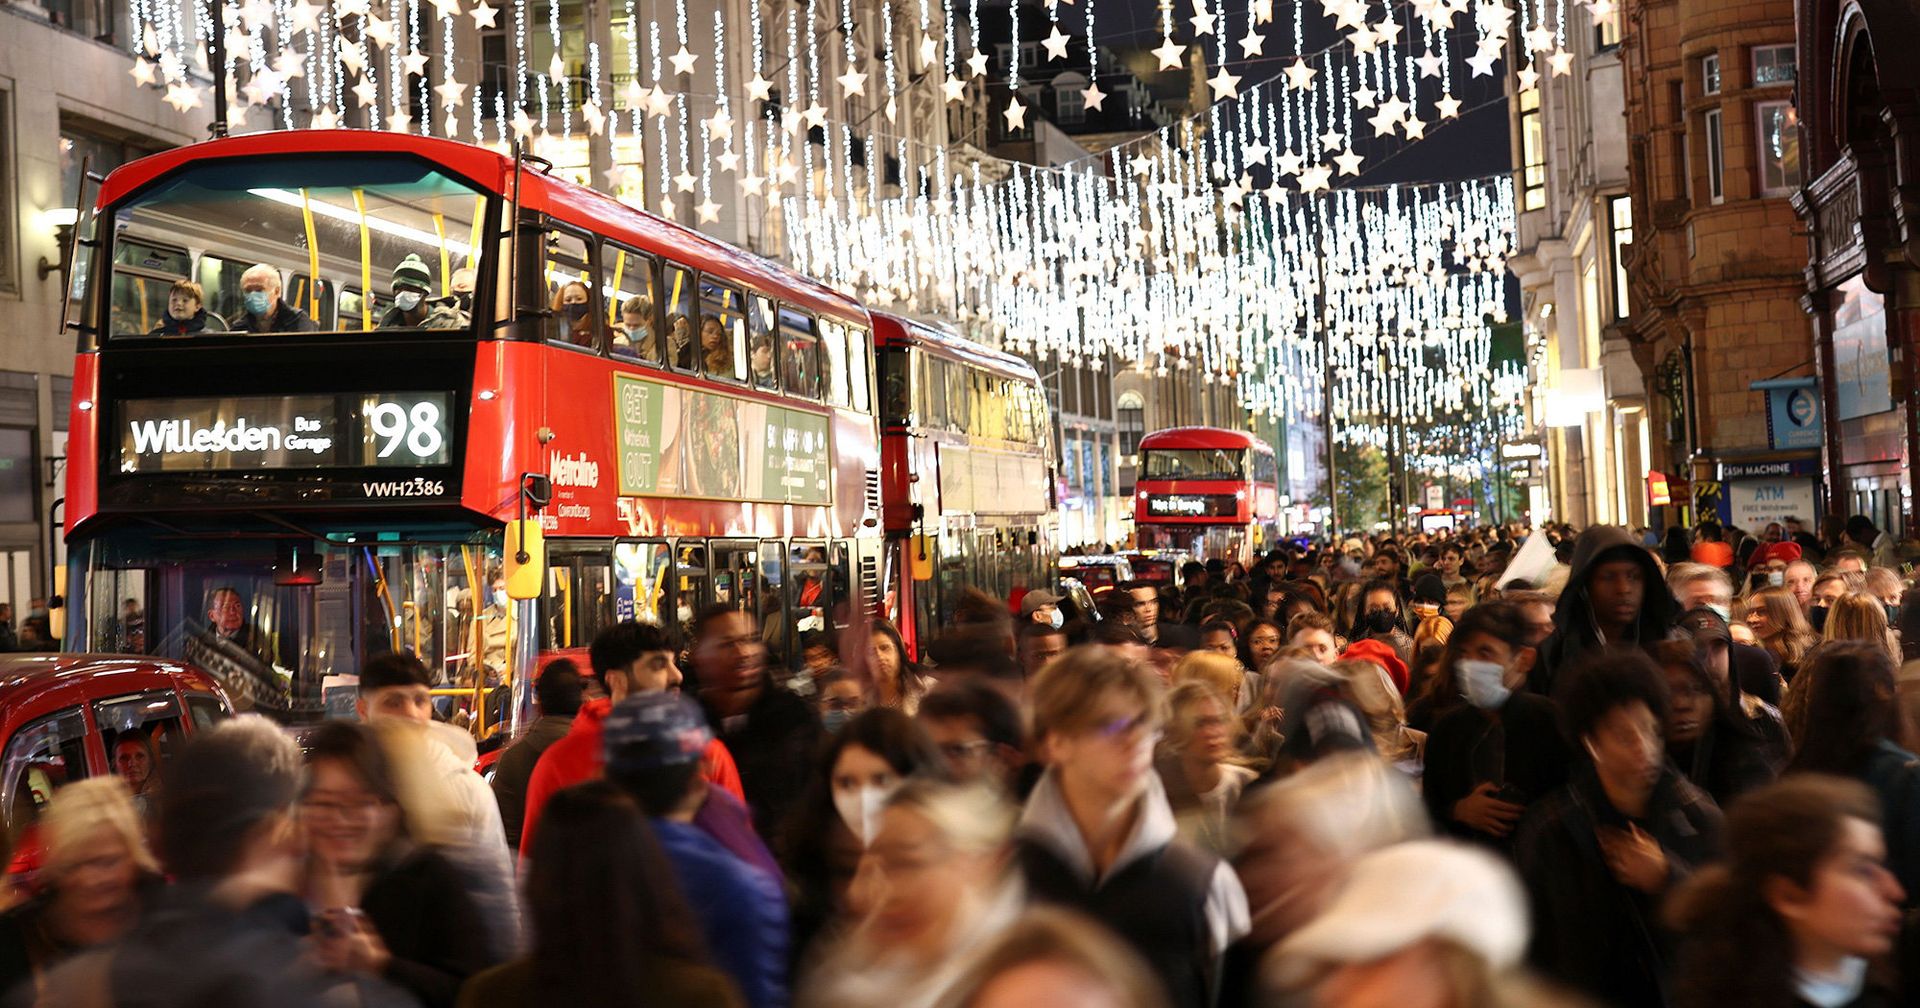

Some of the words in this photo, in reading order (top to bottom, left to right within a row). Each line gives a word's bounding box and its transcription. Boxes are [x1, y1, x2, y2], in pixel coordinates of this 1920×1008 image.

[622, 383, 648, 424] GET
[130, 417, 280, 453] Willesden
[294, 416, 322, 432] Bus
[371, 402, 442, 457] 98
[284, 434, 332, 454] Garage
[550, 449, 599, 488] Metroline
[626, 452, 652, 489] OUT
[1723, 466, 1743, 477] CASH
[1745, 463, 1791, 475] MACHINE
[363, 480, 444, 497] VWH2386
[1755, 484, 1785, 501] ATM
